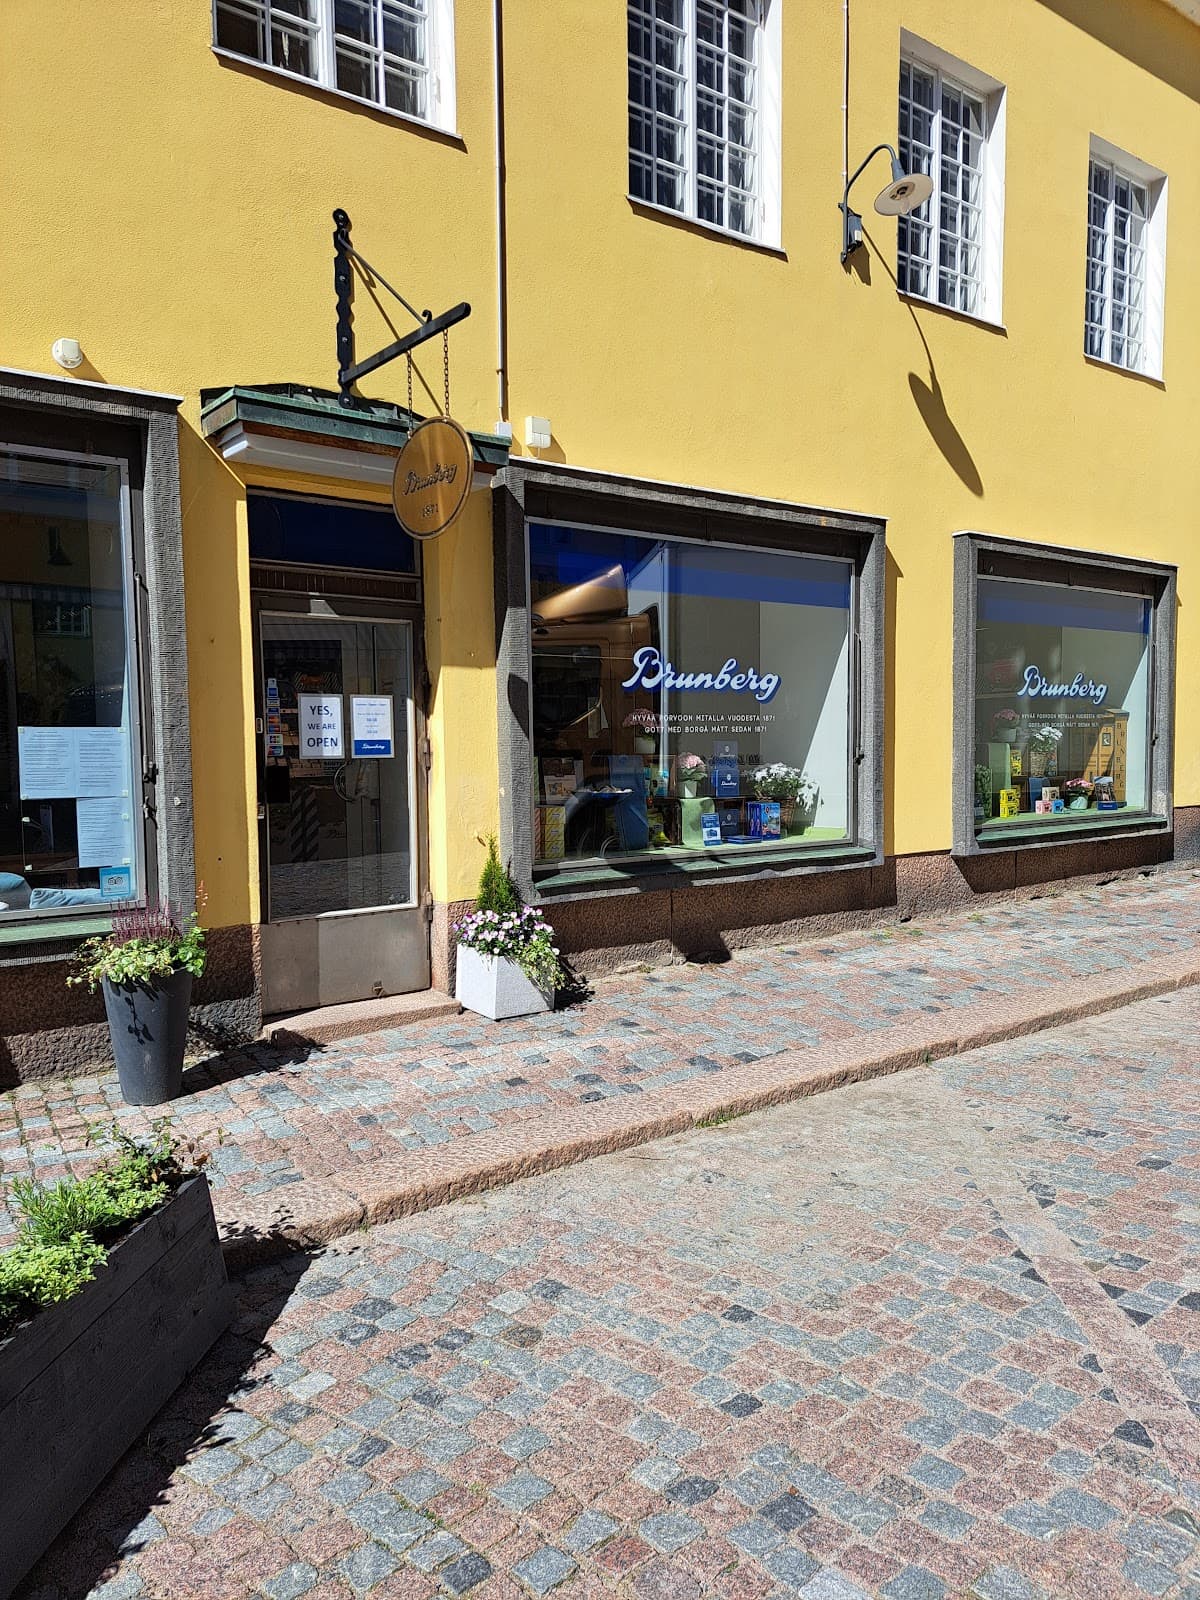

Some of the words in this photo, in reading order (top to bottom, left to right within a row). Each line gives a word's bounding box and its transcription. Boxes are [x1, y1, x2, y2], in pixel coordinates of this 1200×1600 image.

[622, 646, 781, 703] Brunberg
[1017, 665, 1108, 704] Brunberg
[309, 705, 333, 717] YES,
[696, 713, 725, 721] MITALLA
[727, 713, 760, 721] VUODESTA
[644, 726, 664, 734] GOTT
[667, 725, 682, 733] MED
[685, 724, 709, 733] BORGÅ
[711, 725, 728, 733] MÅTT
[307, 737, 338, 748] OPEN
